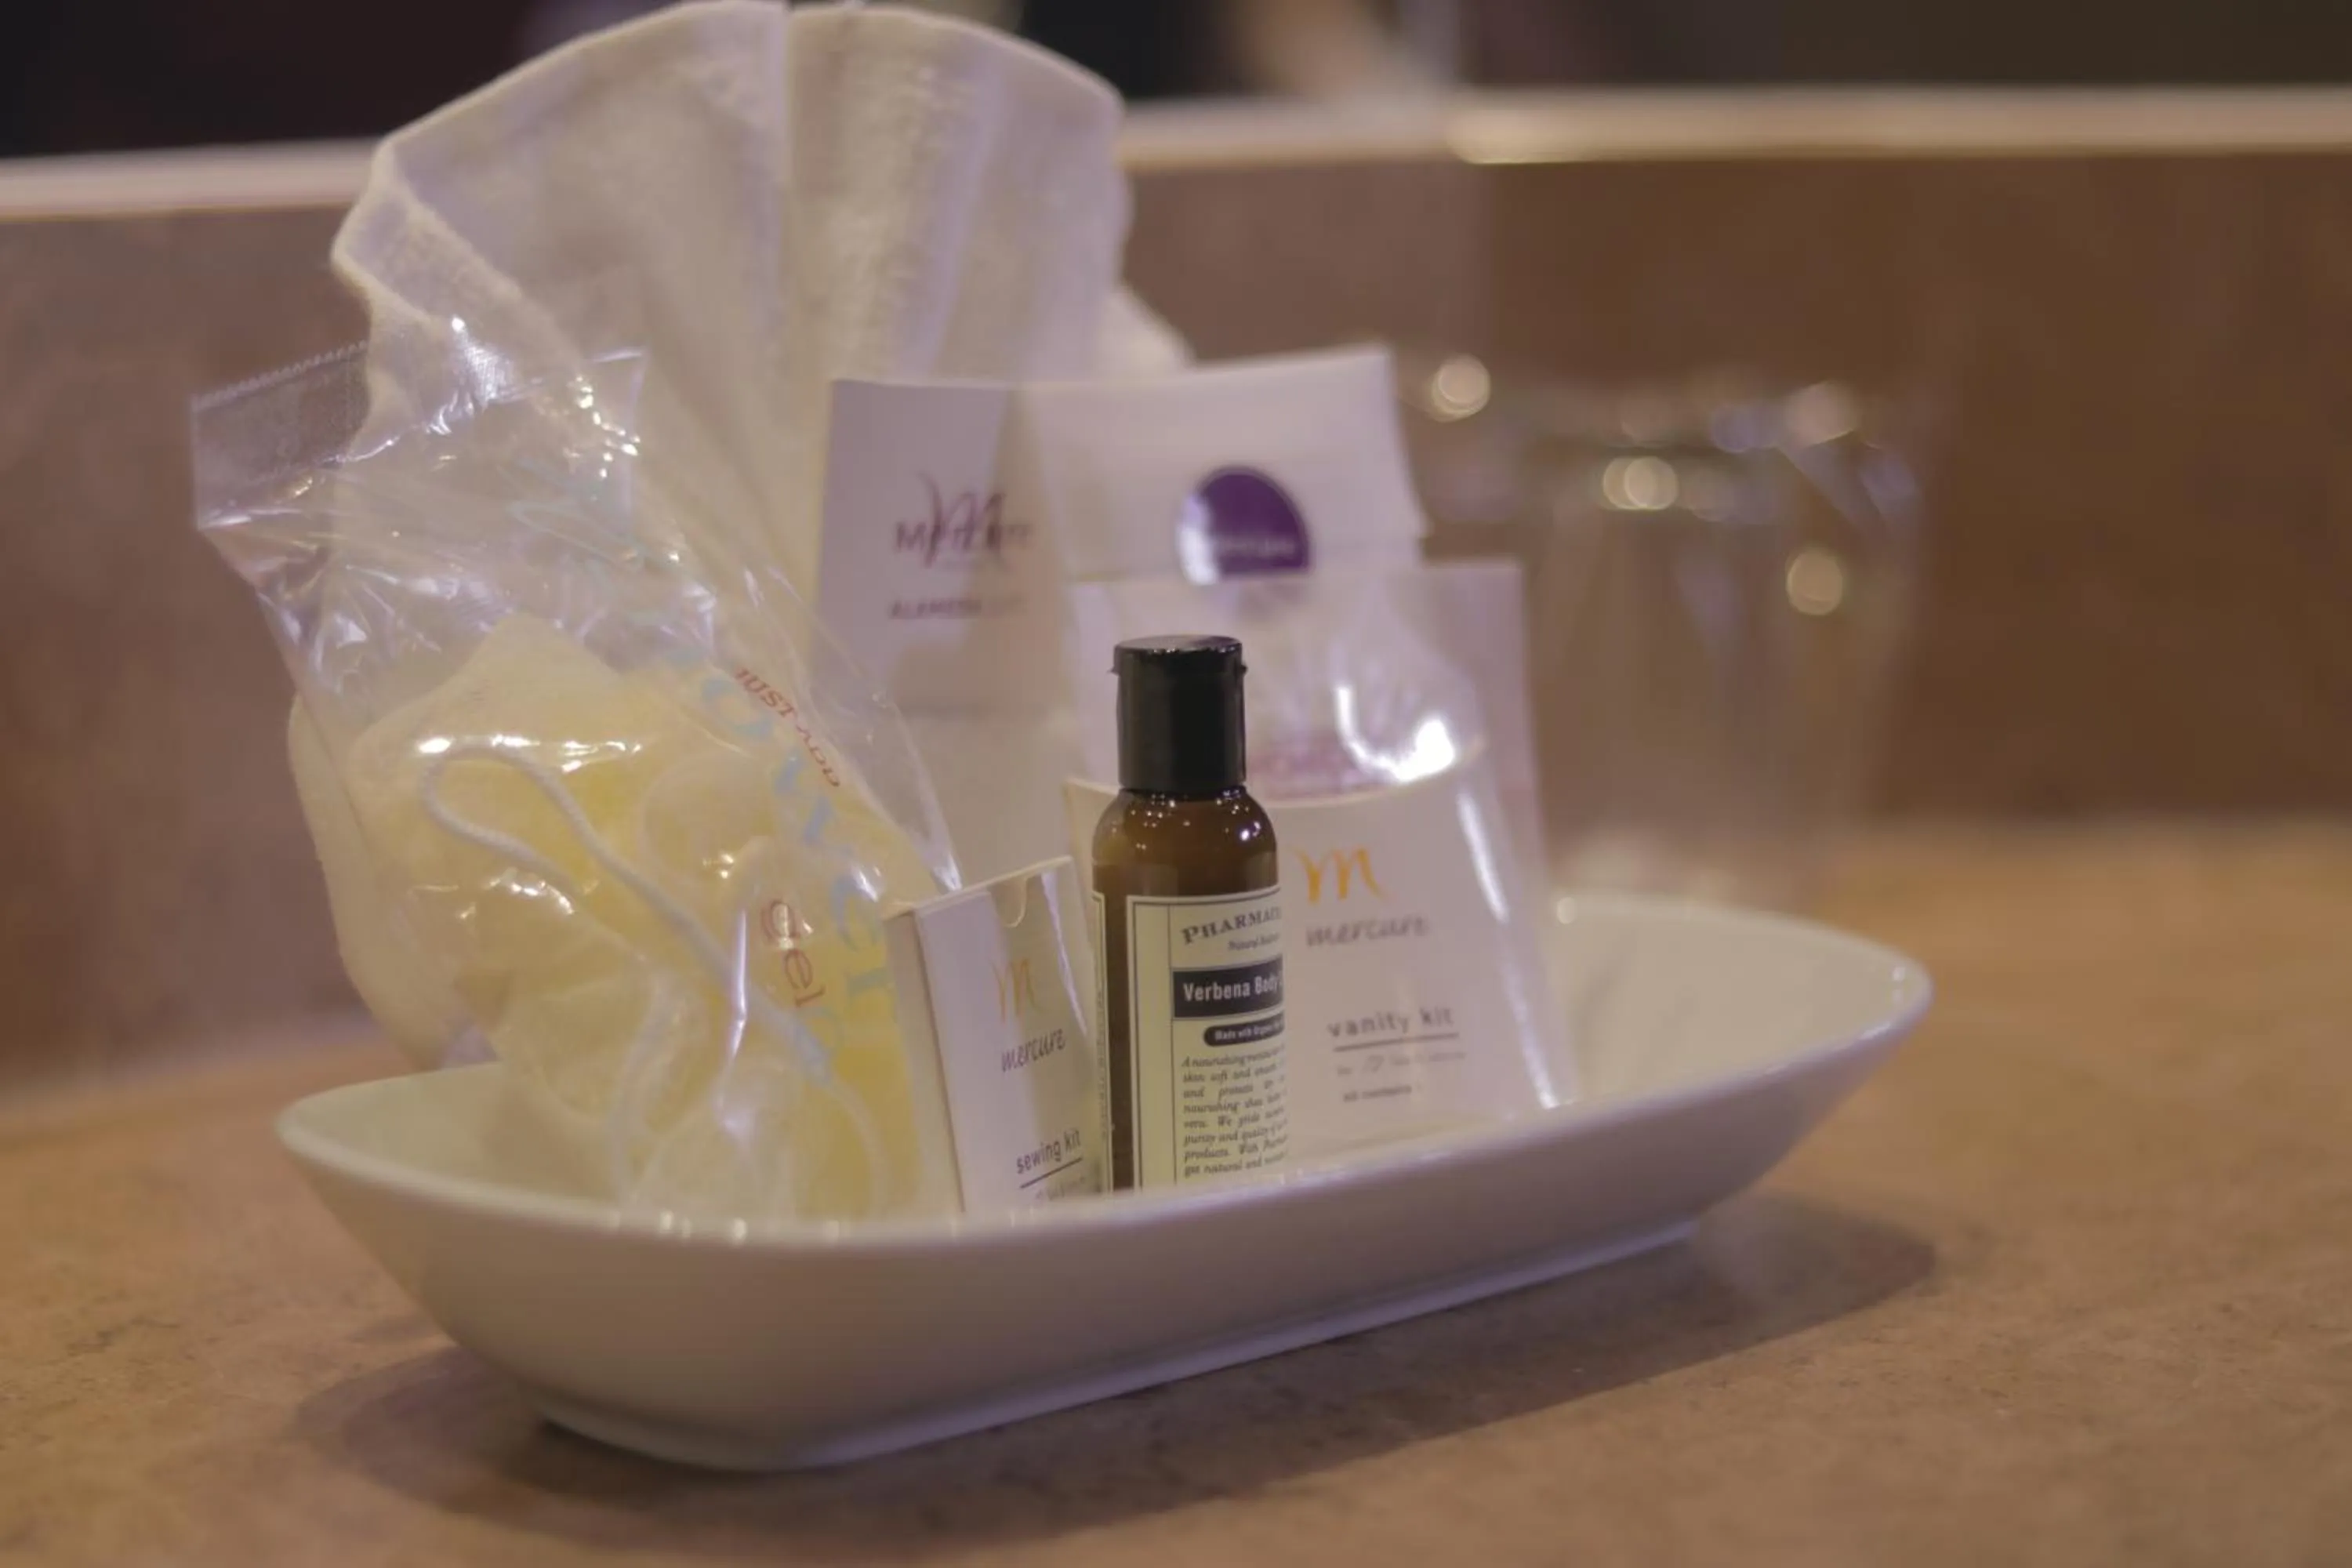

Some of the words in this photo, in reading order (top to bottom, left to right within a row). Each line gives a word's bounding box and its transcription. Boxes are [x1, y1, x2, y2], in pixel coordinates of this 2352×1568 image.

[1182, 981, 1251, 1002] Verbena
[1254, 974, 1279, 996] Body
[1327, 1011, 1410, 1038] vanity
[1419, 1006, 1455, 1028] kit
[1001, 1028, 1066, 1073] mercure
[1017, 1140, 1062, 1174] sewing
[1064, 1129, 1081, 1153] kit
